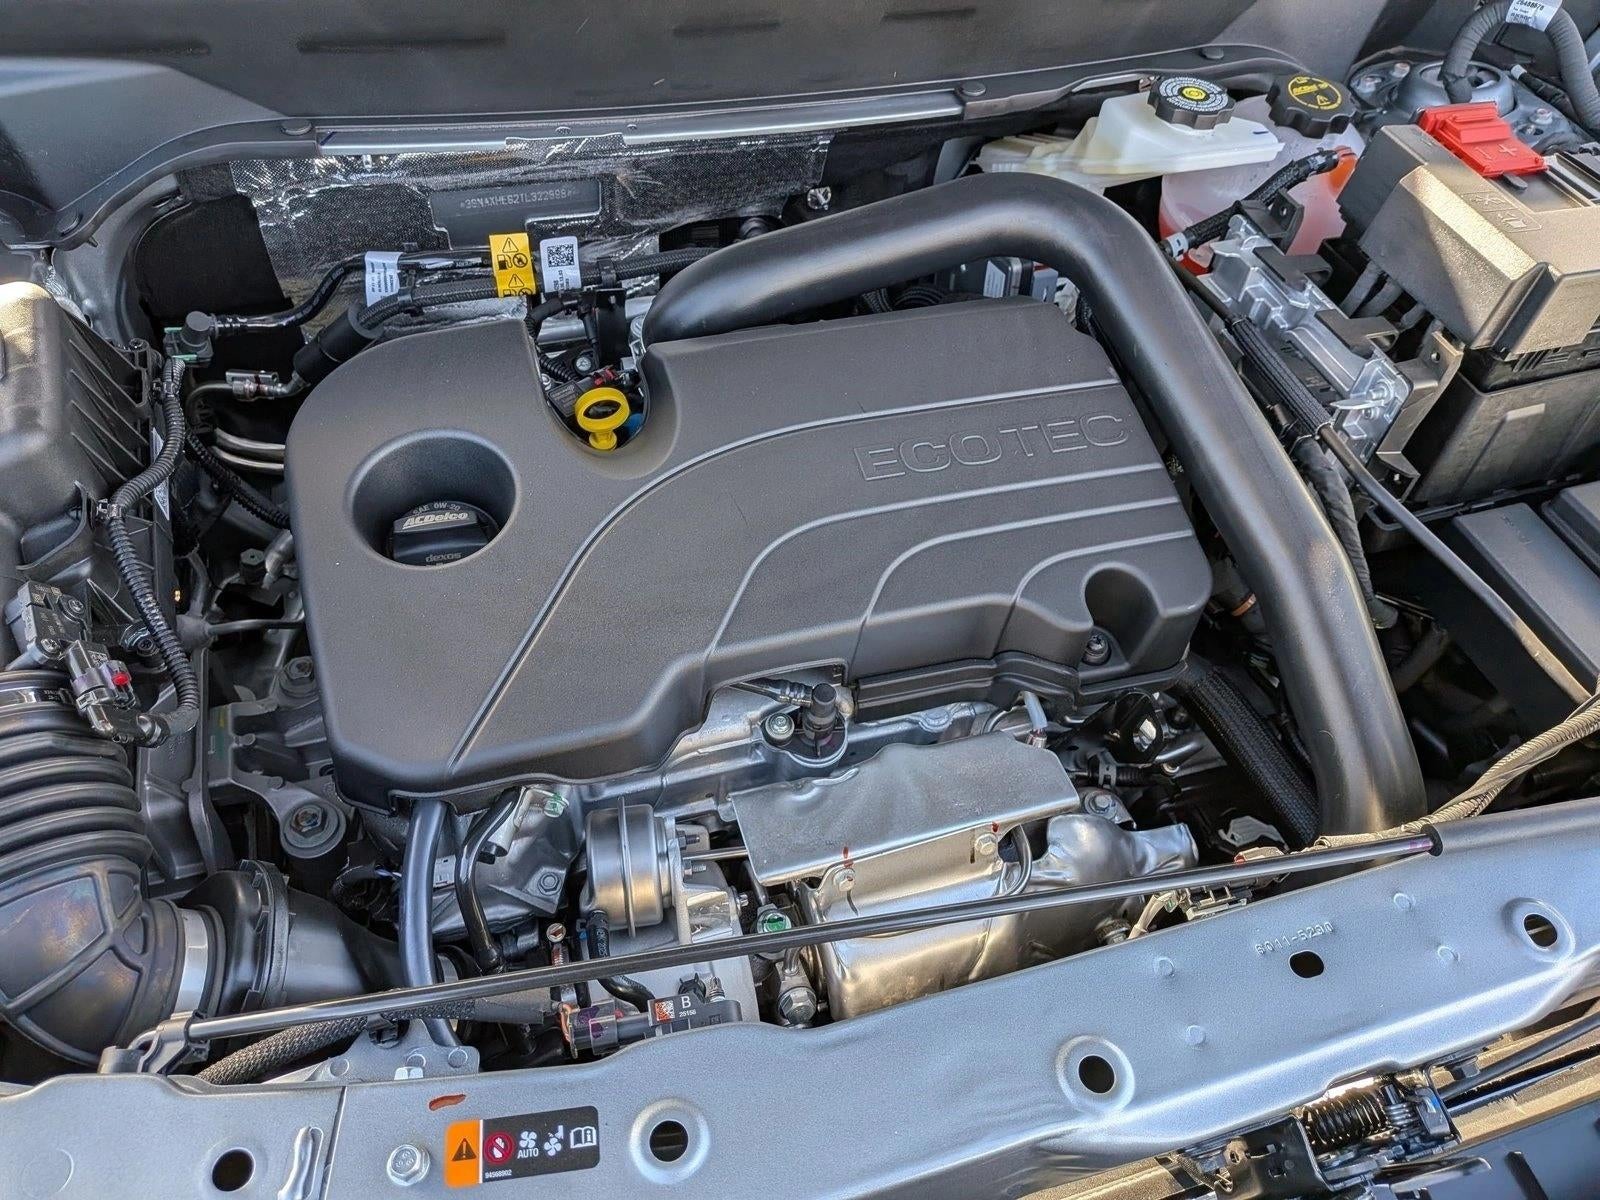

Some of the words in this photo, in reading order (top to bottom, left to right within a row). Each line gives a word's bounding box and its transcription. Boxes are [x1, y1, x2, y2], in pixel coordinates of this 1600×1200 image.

[853, 415, 1129, 481] ECOTEC
[413, 504, 430, 516] SAE
[433, 502, 461, 512] 0W-20
[402, 512, 469, 529] ACDelco
[681, 996, 691, 1008] B
[518, 1148, 539, 1159] AUTO
